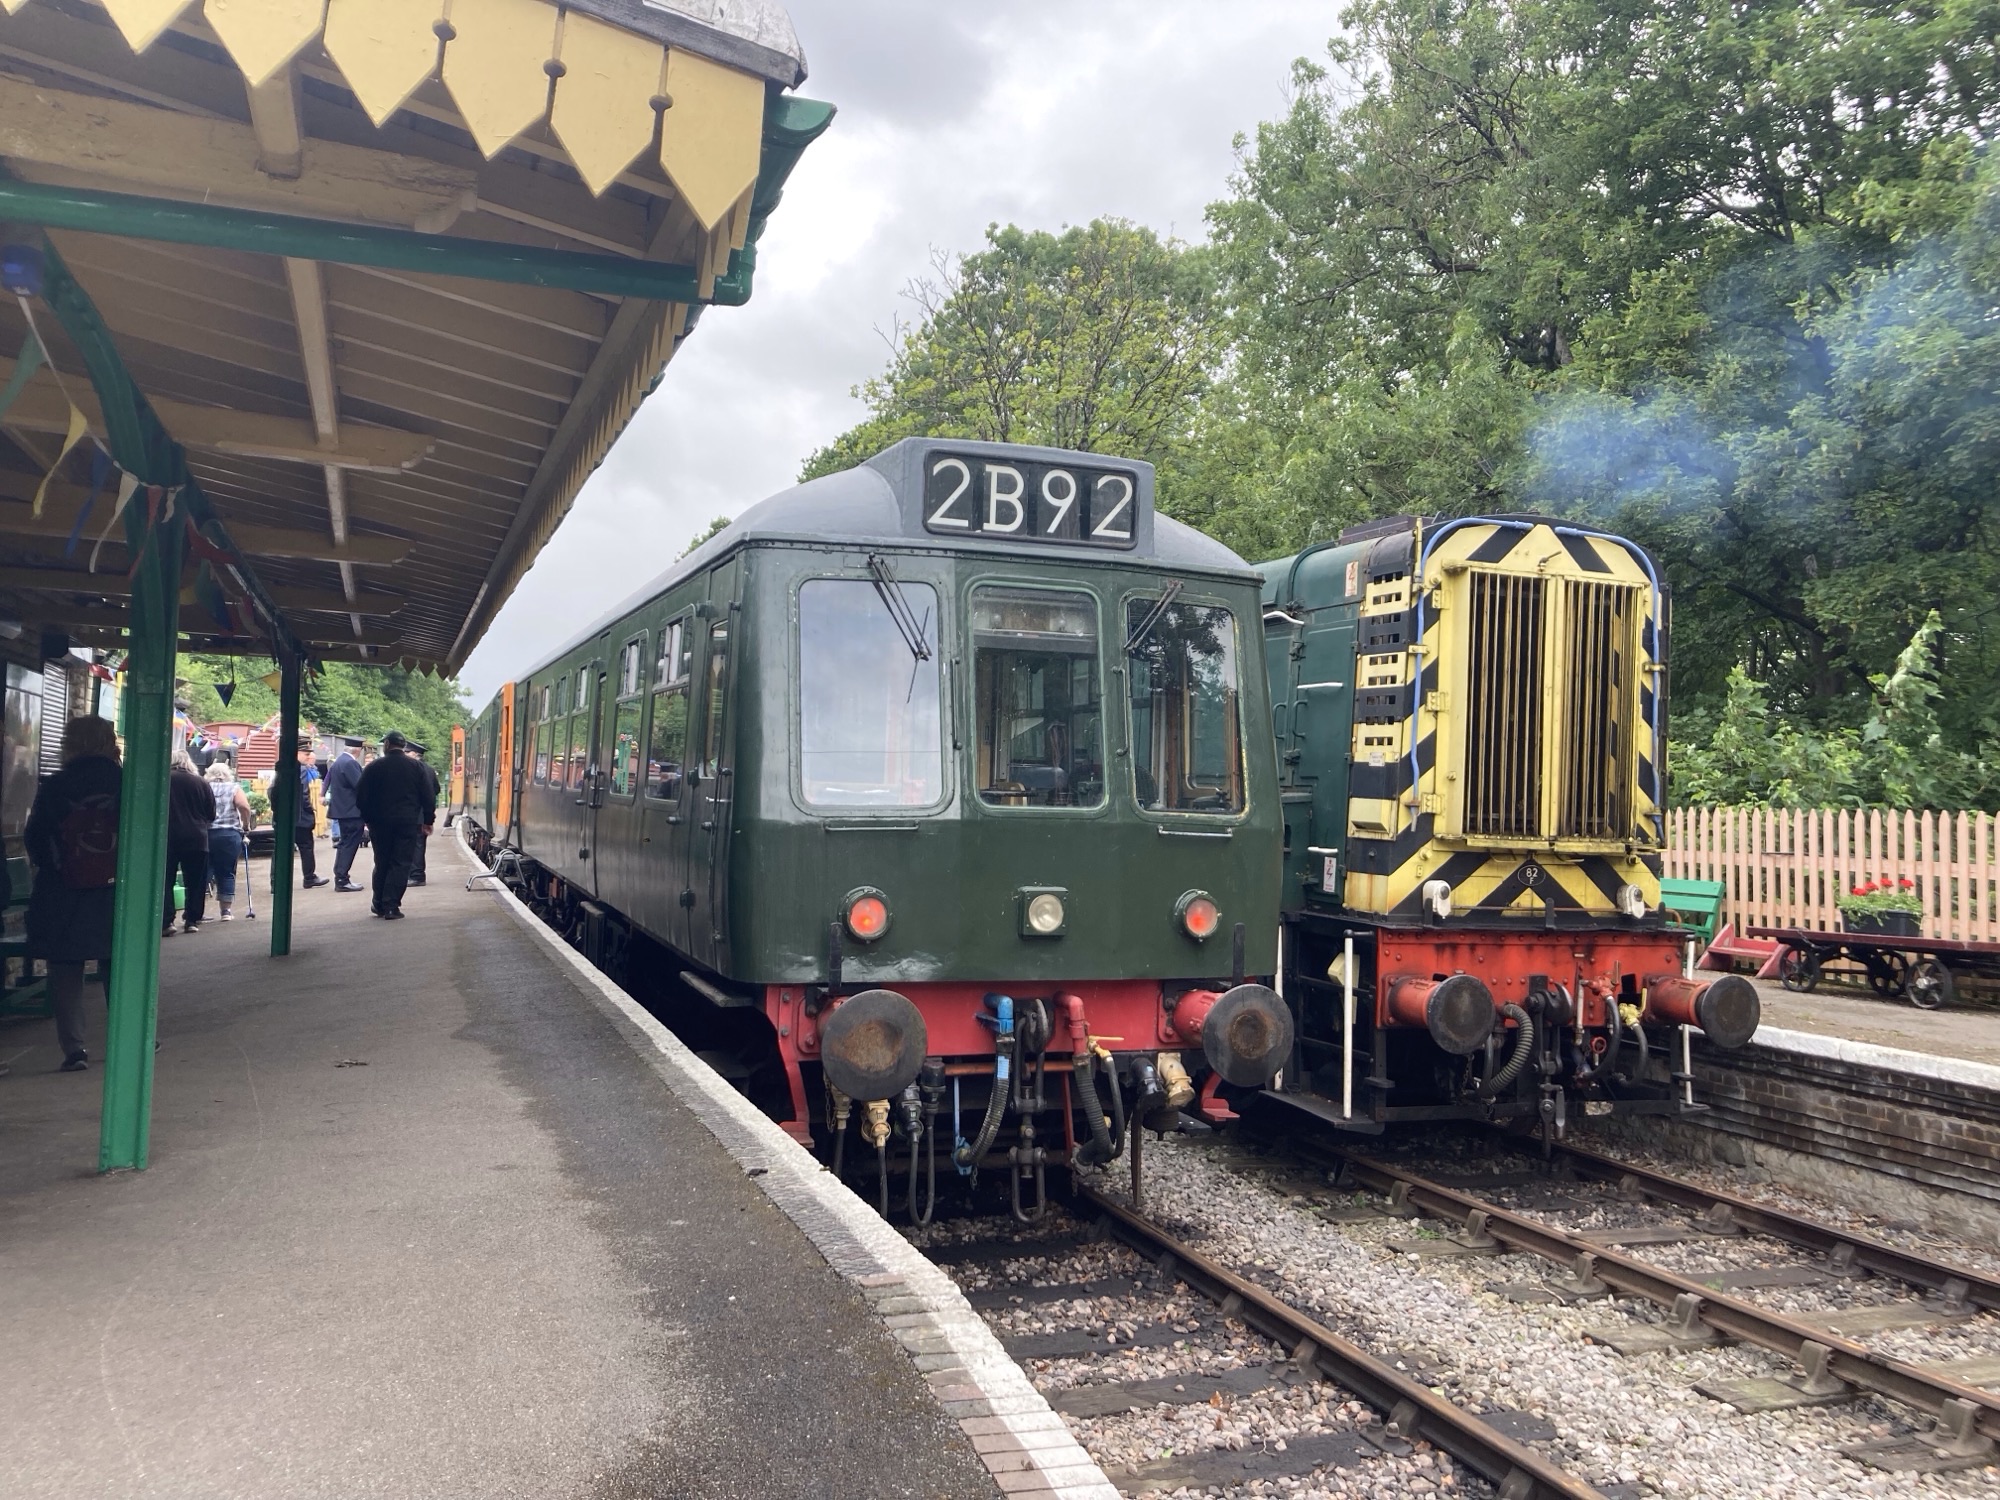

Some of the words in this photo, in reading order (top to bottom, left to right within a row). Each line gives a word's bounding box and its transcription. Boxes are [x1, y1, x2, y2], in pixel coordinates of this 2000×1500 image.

[927, 458, 1134, 539] 2B92
[1526, 867, 1538, 878] 82
[1529, 877, 1535, 885] F
